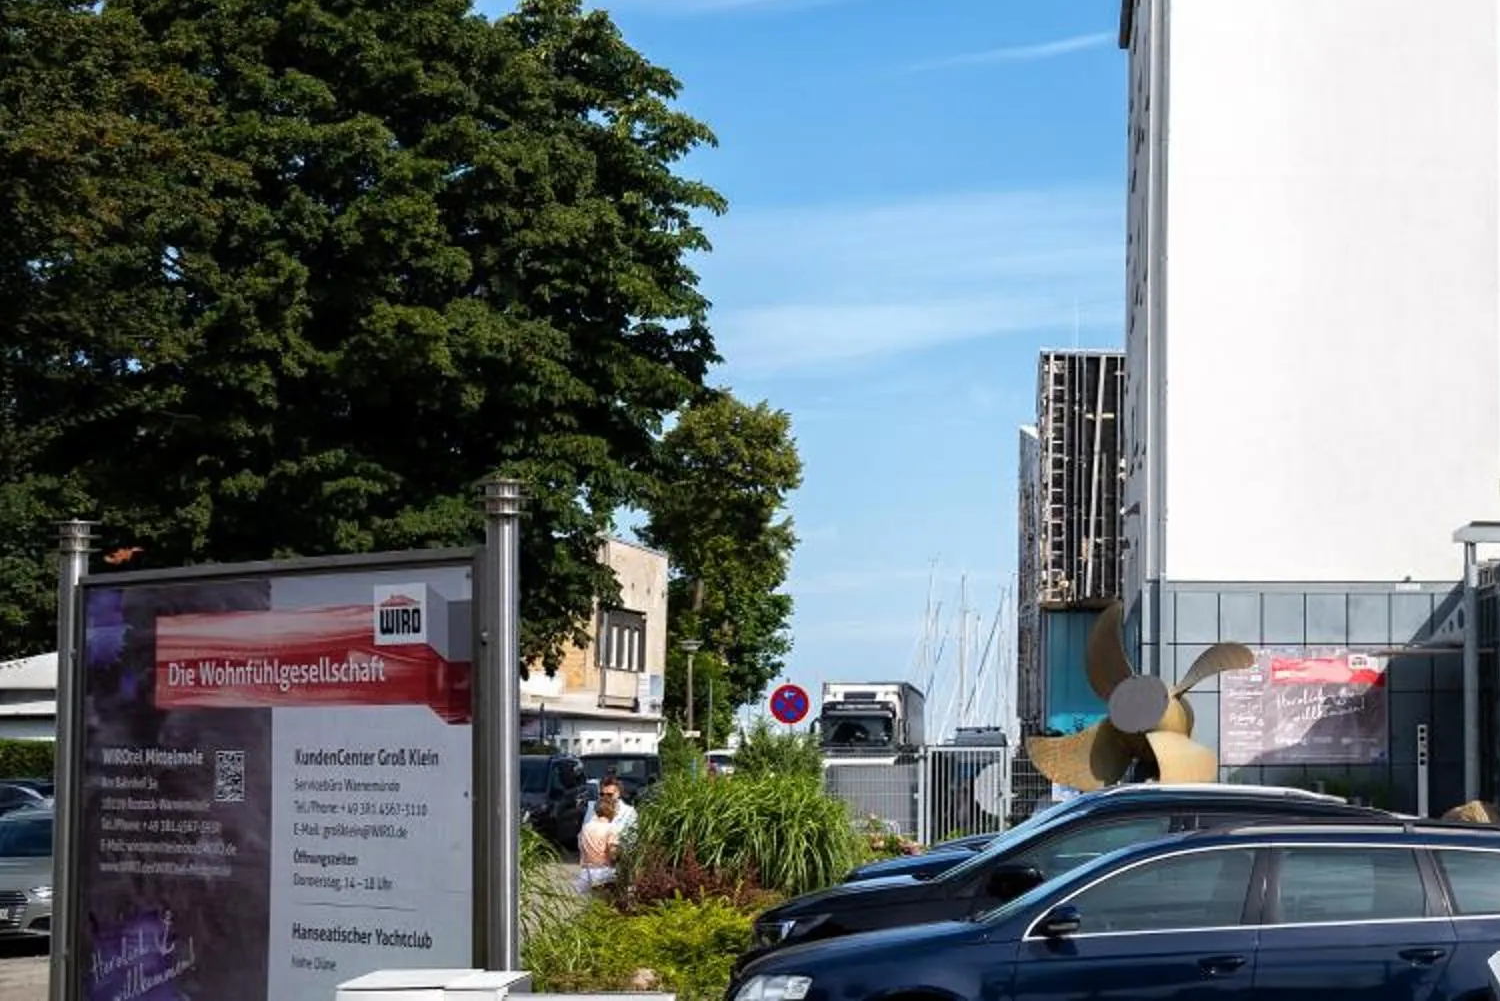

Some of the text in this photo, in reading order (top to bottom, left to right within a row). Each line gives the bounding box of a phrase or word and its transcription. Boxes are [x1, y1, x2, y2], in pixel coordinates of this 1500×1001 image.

[379, 608, 421, 635] WIRO
[168, 656, 386, 691] Die Wohnfühlgesellschaft
[295, 748, 440, 766] KundenCenter Groß Klein
[292, 923, 433, 949] Hanseatischer Yachtclub
